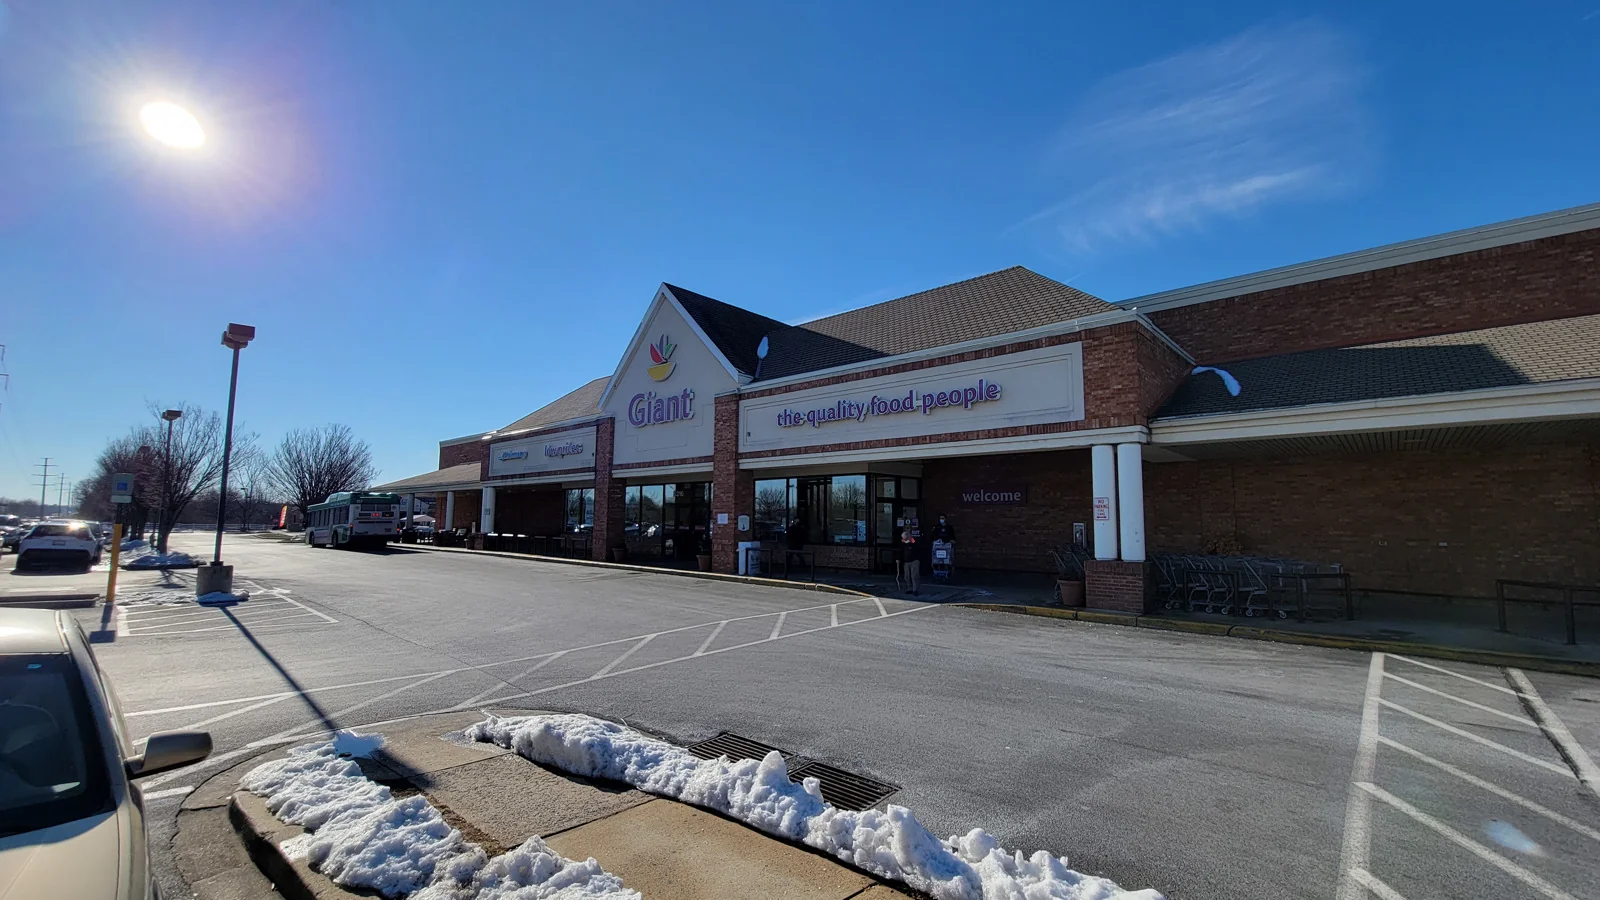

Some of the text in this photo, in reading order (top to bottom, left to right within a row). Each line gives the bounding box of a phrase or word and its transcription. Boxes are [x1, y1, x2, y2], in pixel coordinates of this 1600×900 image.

[628, 388, 695, 427] Giant
[777, 378, 1002, 428] the quality food people
[962, 489, 1022, 502] welcome
